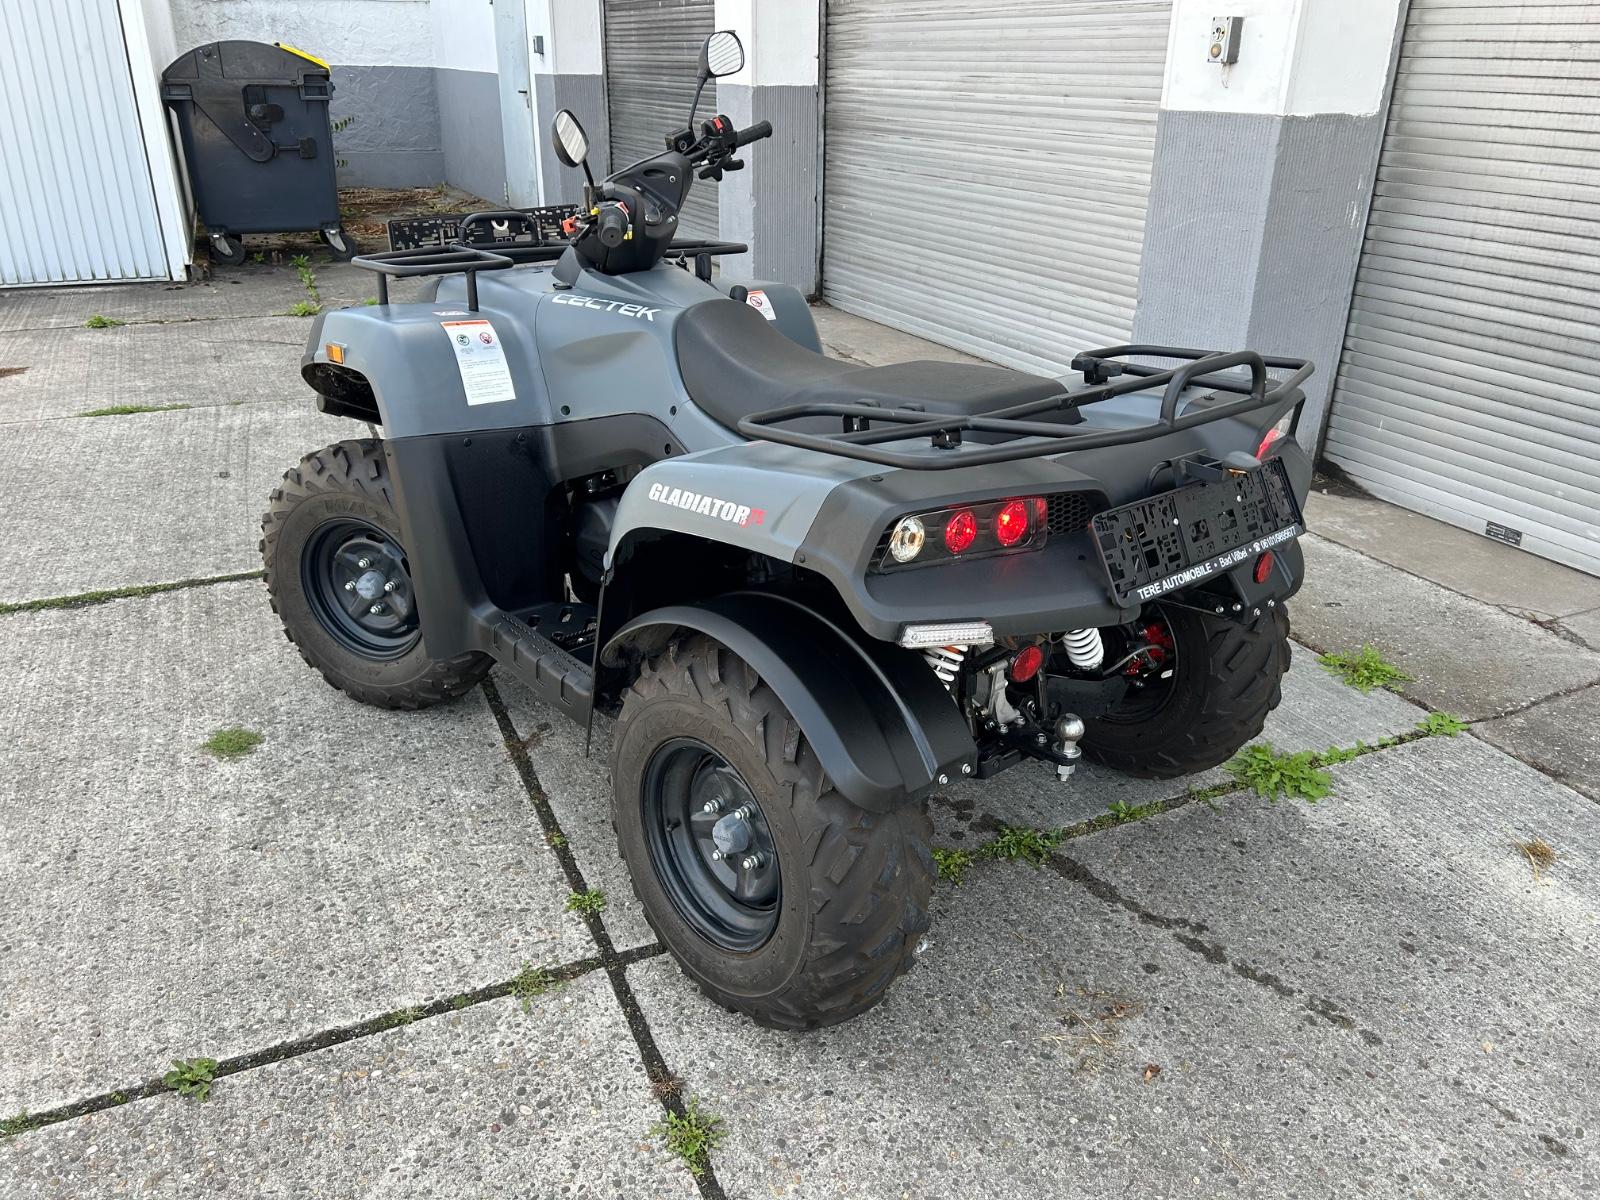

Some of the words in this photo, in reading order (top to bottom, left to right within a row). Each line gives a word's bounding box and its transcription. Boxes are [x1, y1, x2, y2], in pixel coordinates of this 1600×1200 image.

[648, 482, 751, 526] GLADIATOR
[1136, 582, 1162, 600] TERE
[1162, 562, 1213, 591] AUTOMOBILE
[1218, 554, 1233, 568] Bad
